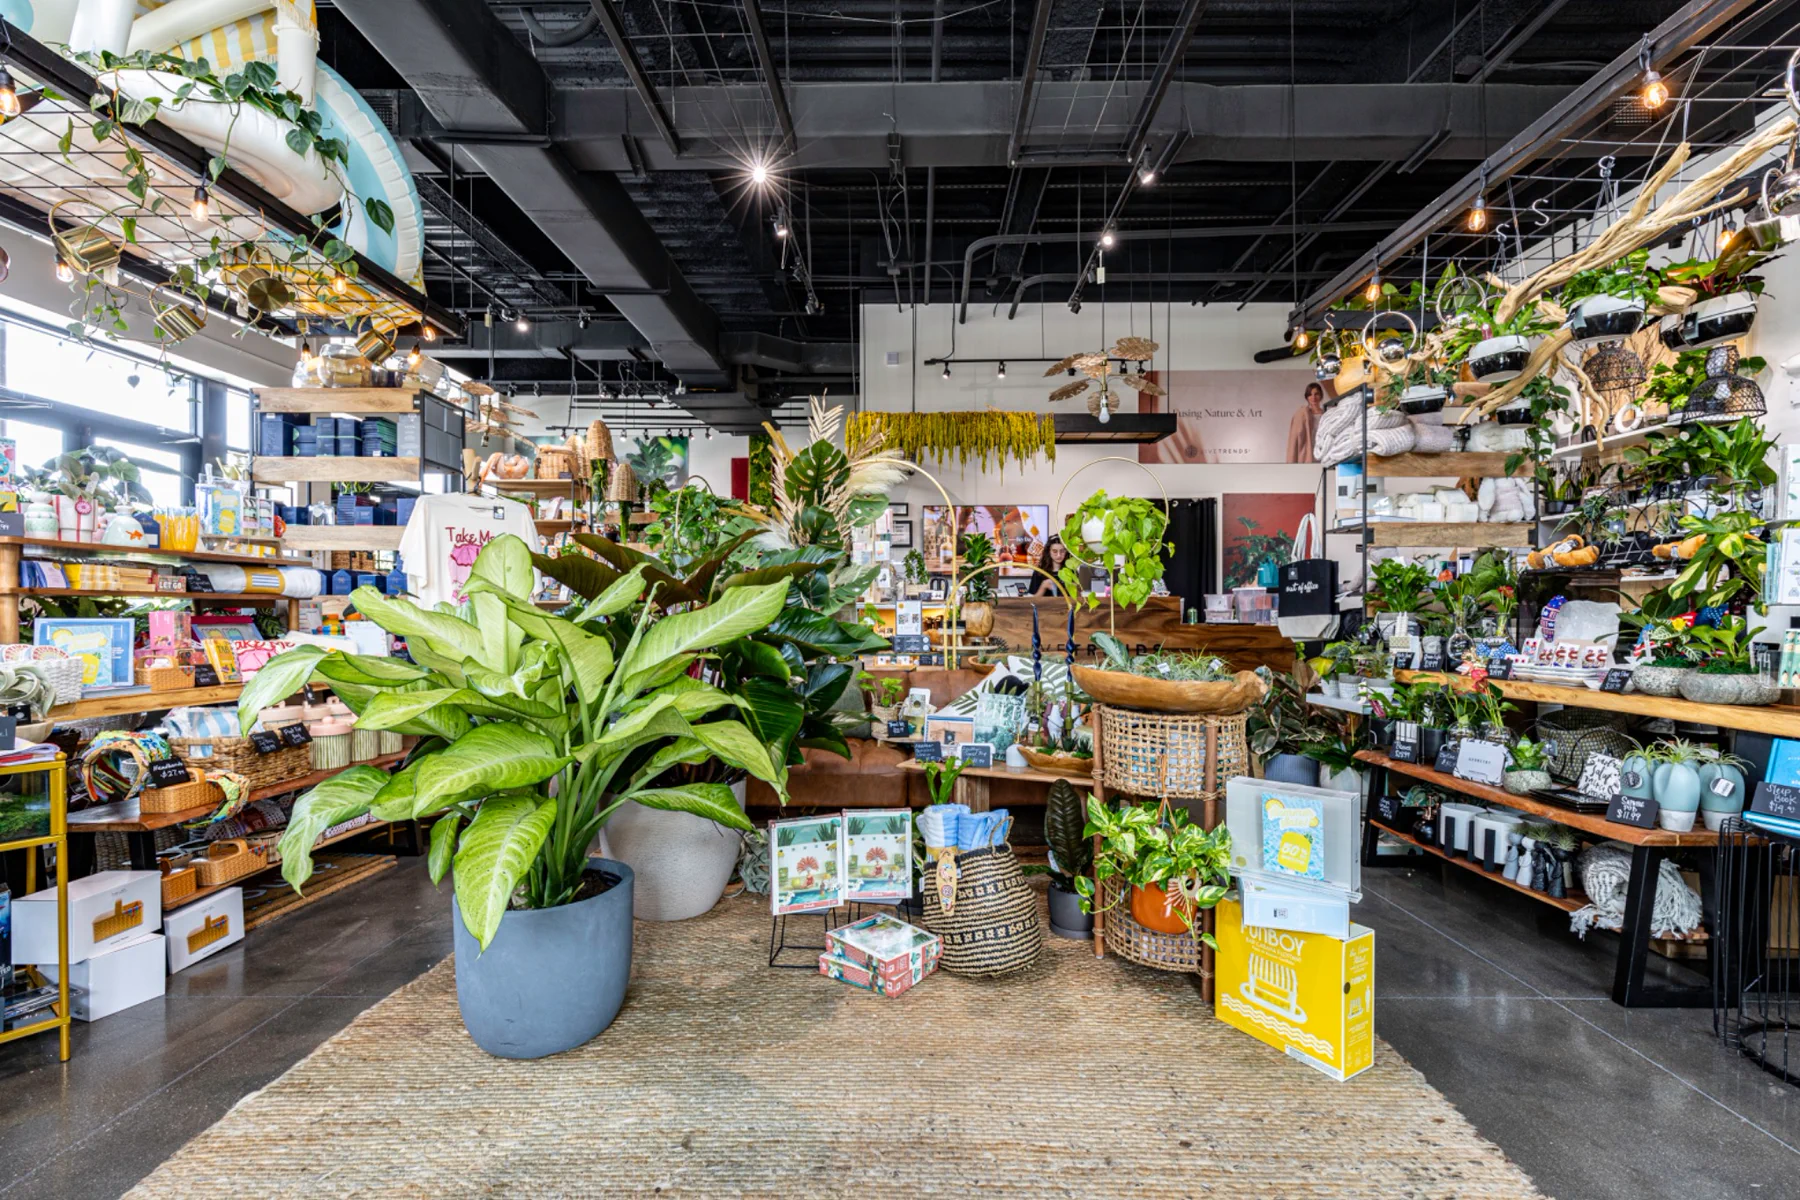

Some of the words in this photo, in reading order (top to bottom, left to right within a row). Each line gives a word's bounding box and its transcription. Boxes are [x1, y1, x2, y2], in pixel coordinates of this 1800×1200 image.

[1205, 409, 1235, 418] Nature
[1236, 408, 1245, 417] &
[1248, 409, 1263, 418] Art
[445, 527, 477, 543] Take
[1286, 583, 1299, 592] out
[1016, 643, 1163, 658] LVETRDS
